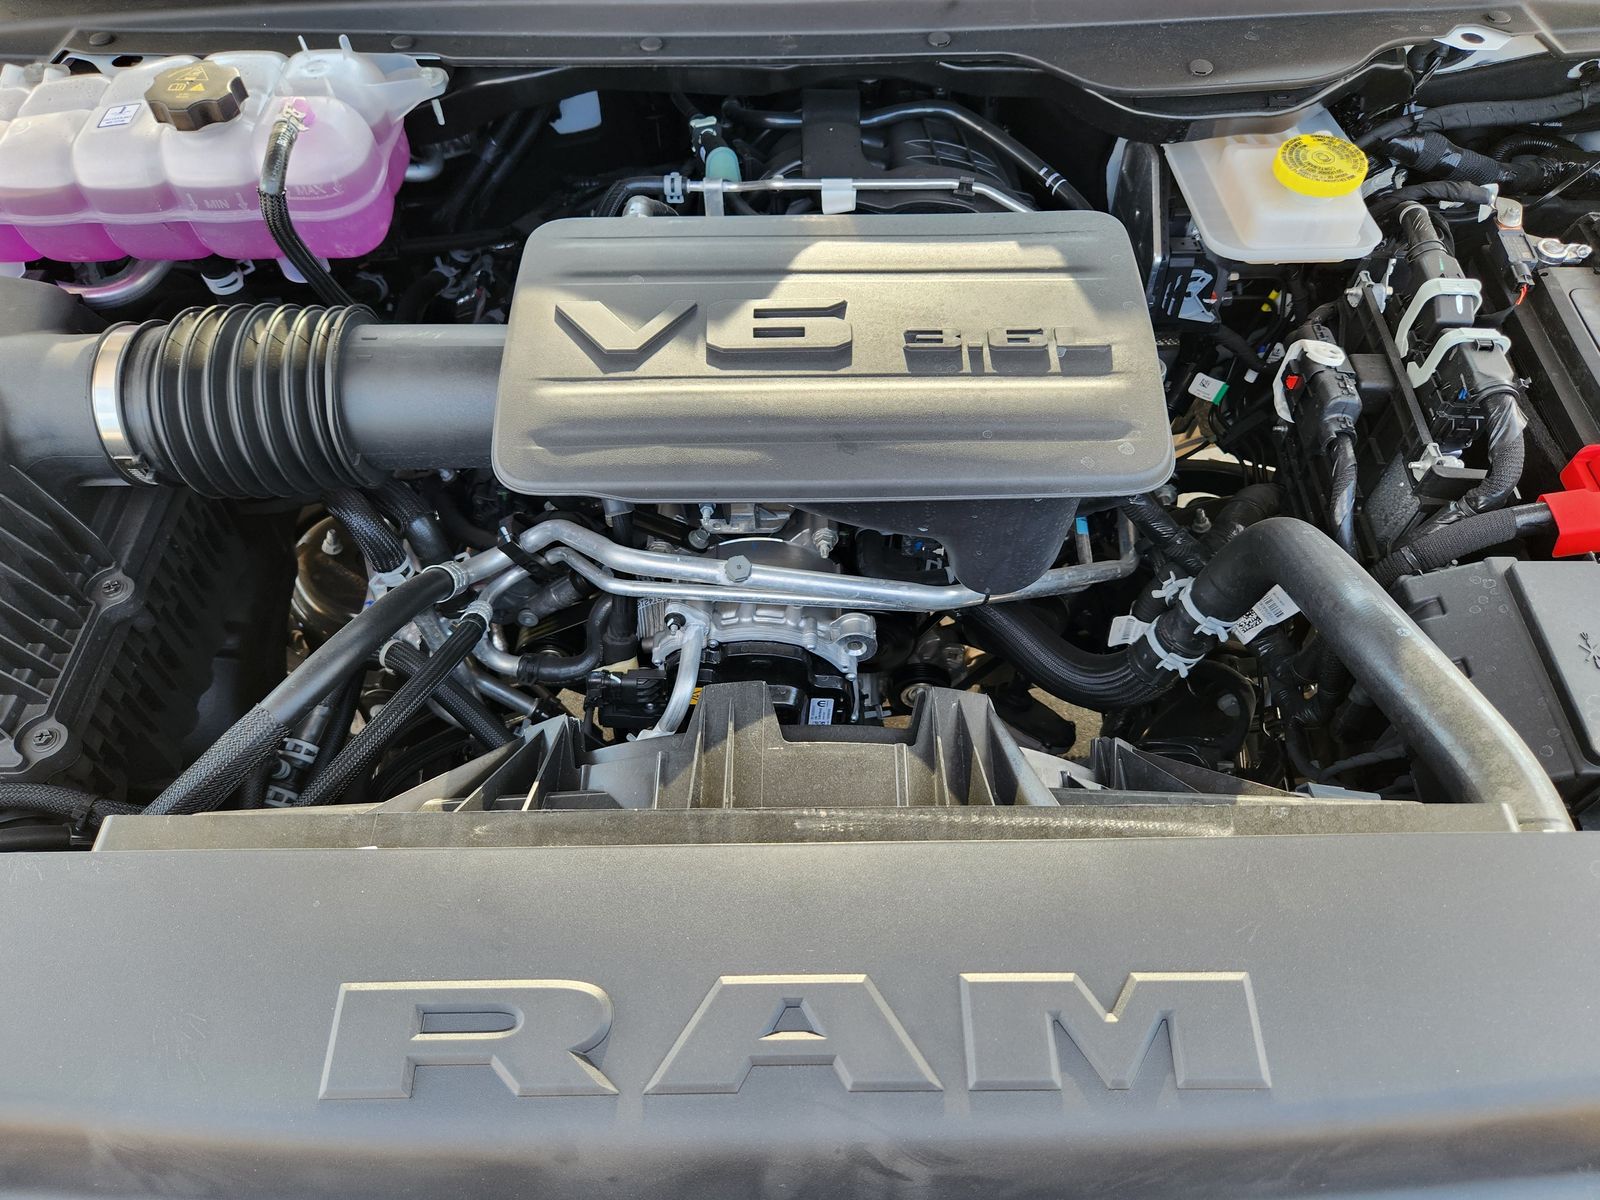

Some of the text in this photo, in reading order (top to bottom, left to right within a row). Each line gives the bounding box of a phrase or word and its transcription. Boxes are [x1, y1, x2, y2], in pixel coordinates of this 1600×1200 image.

[204, 199, 230, 209] MIN
[295, 184, 327, 196] MAX
[554, 299, 853, 373] V6
[318, 971, 1273, 1100] RAM
